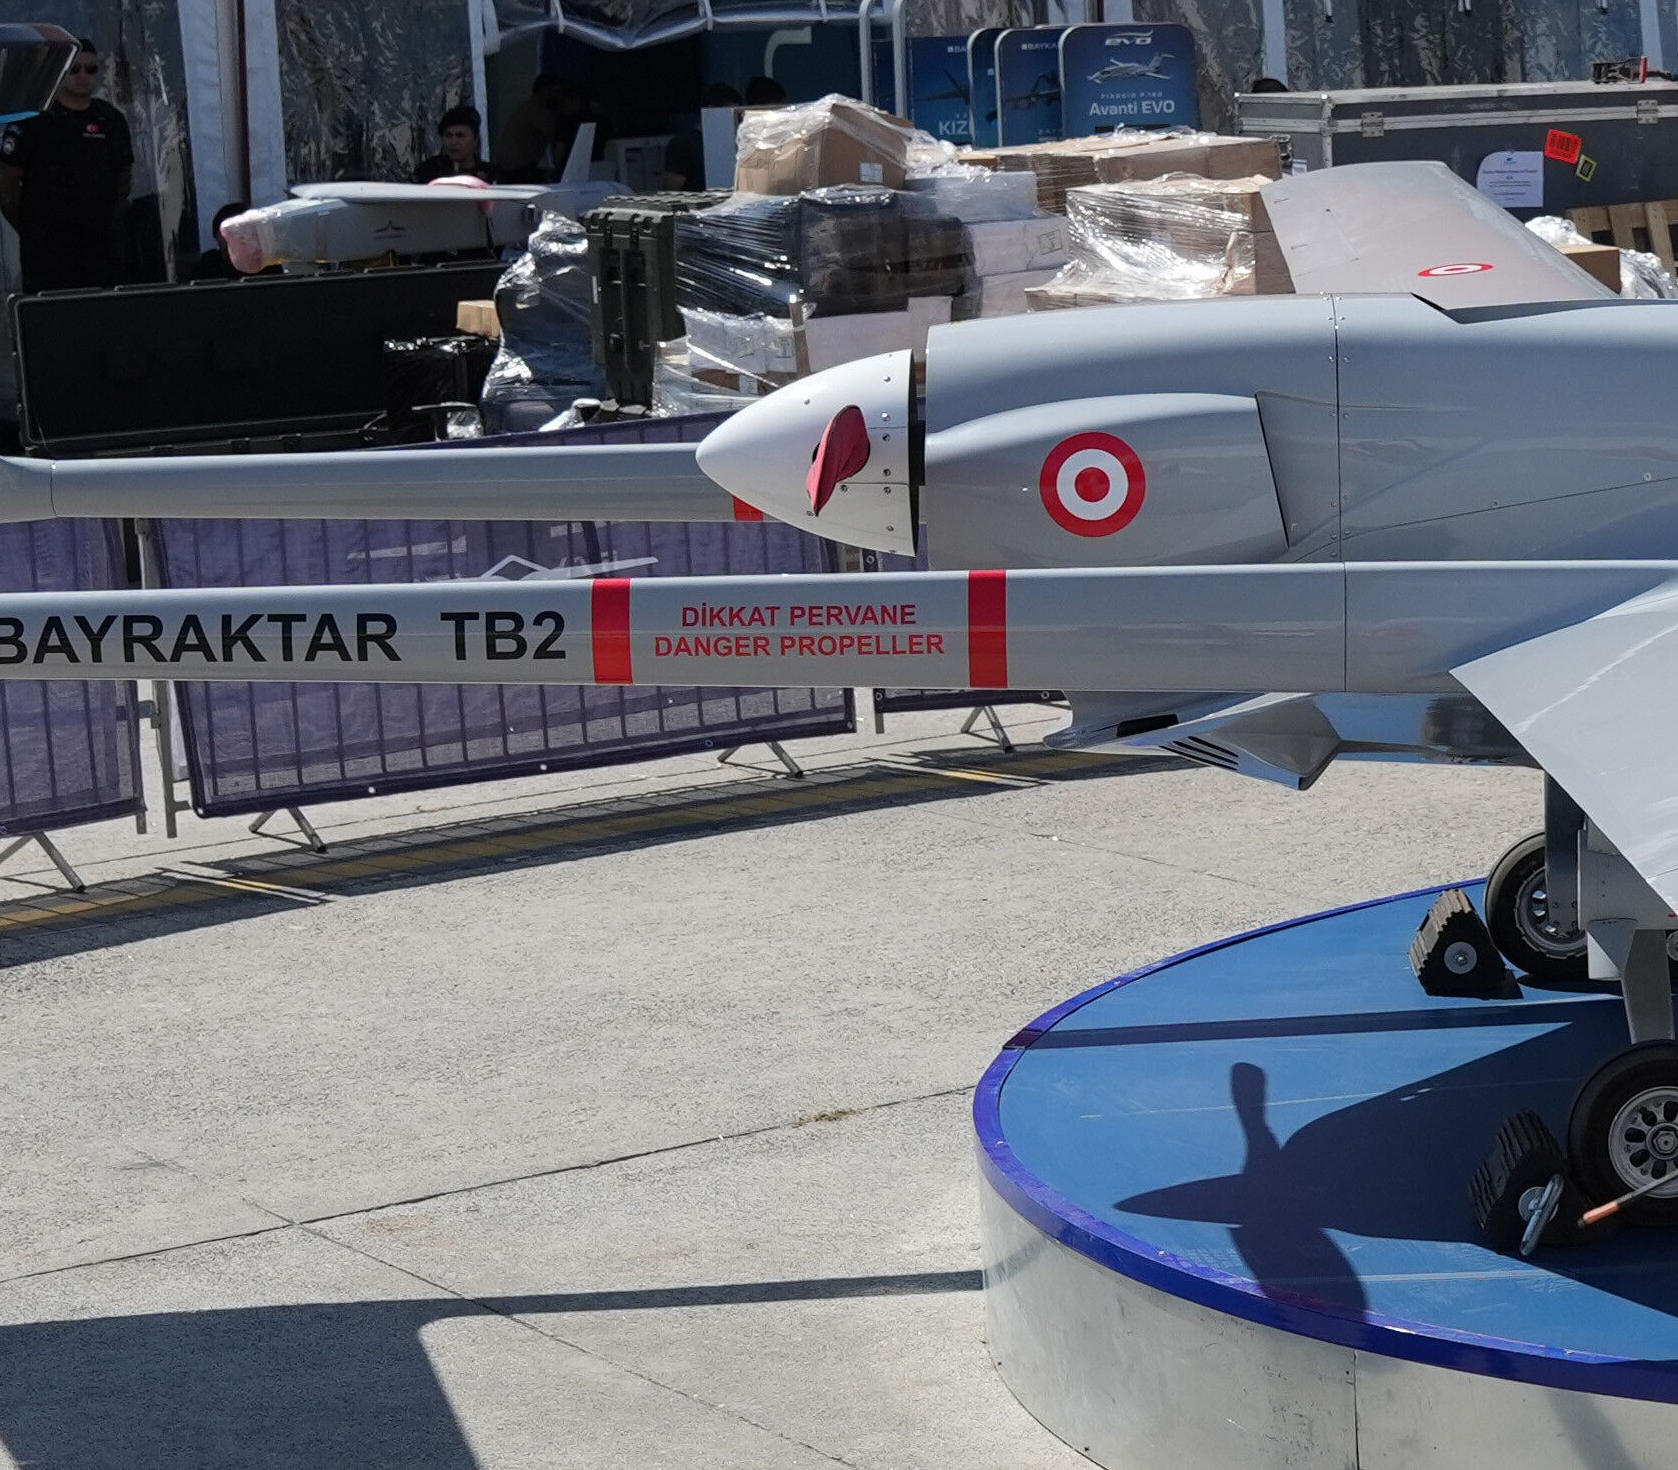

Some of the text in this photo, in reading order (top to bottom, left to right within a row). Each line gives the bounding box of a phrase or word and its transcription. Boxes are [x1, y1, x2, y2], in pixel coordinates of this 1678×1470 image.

[1089, 99, 1175, 116] Avanti EVO
[682, 600, 917, 627] DİKKAT PERVANE
[440, 611, 567, 662] TB2
[654, 632, 944, 658] DANGER PROPELLER
